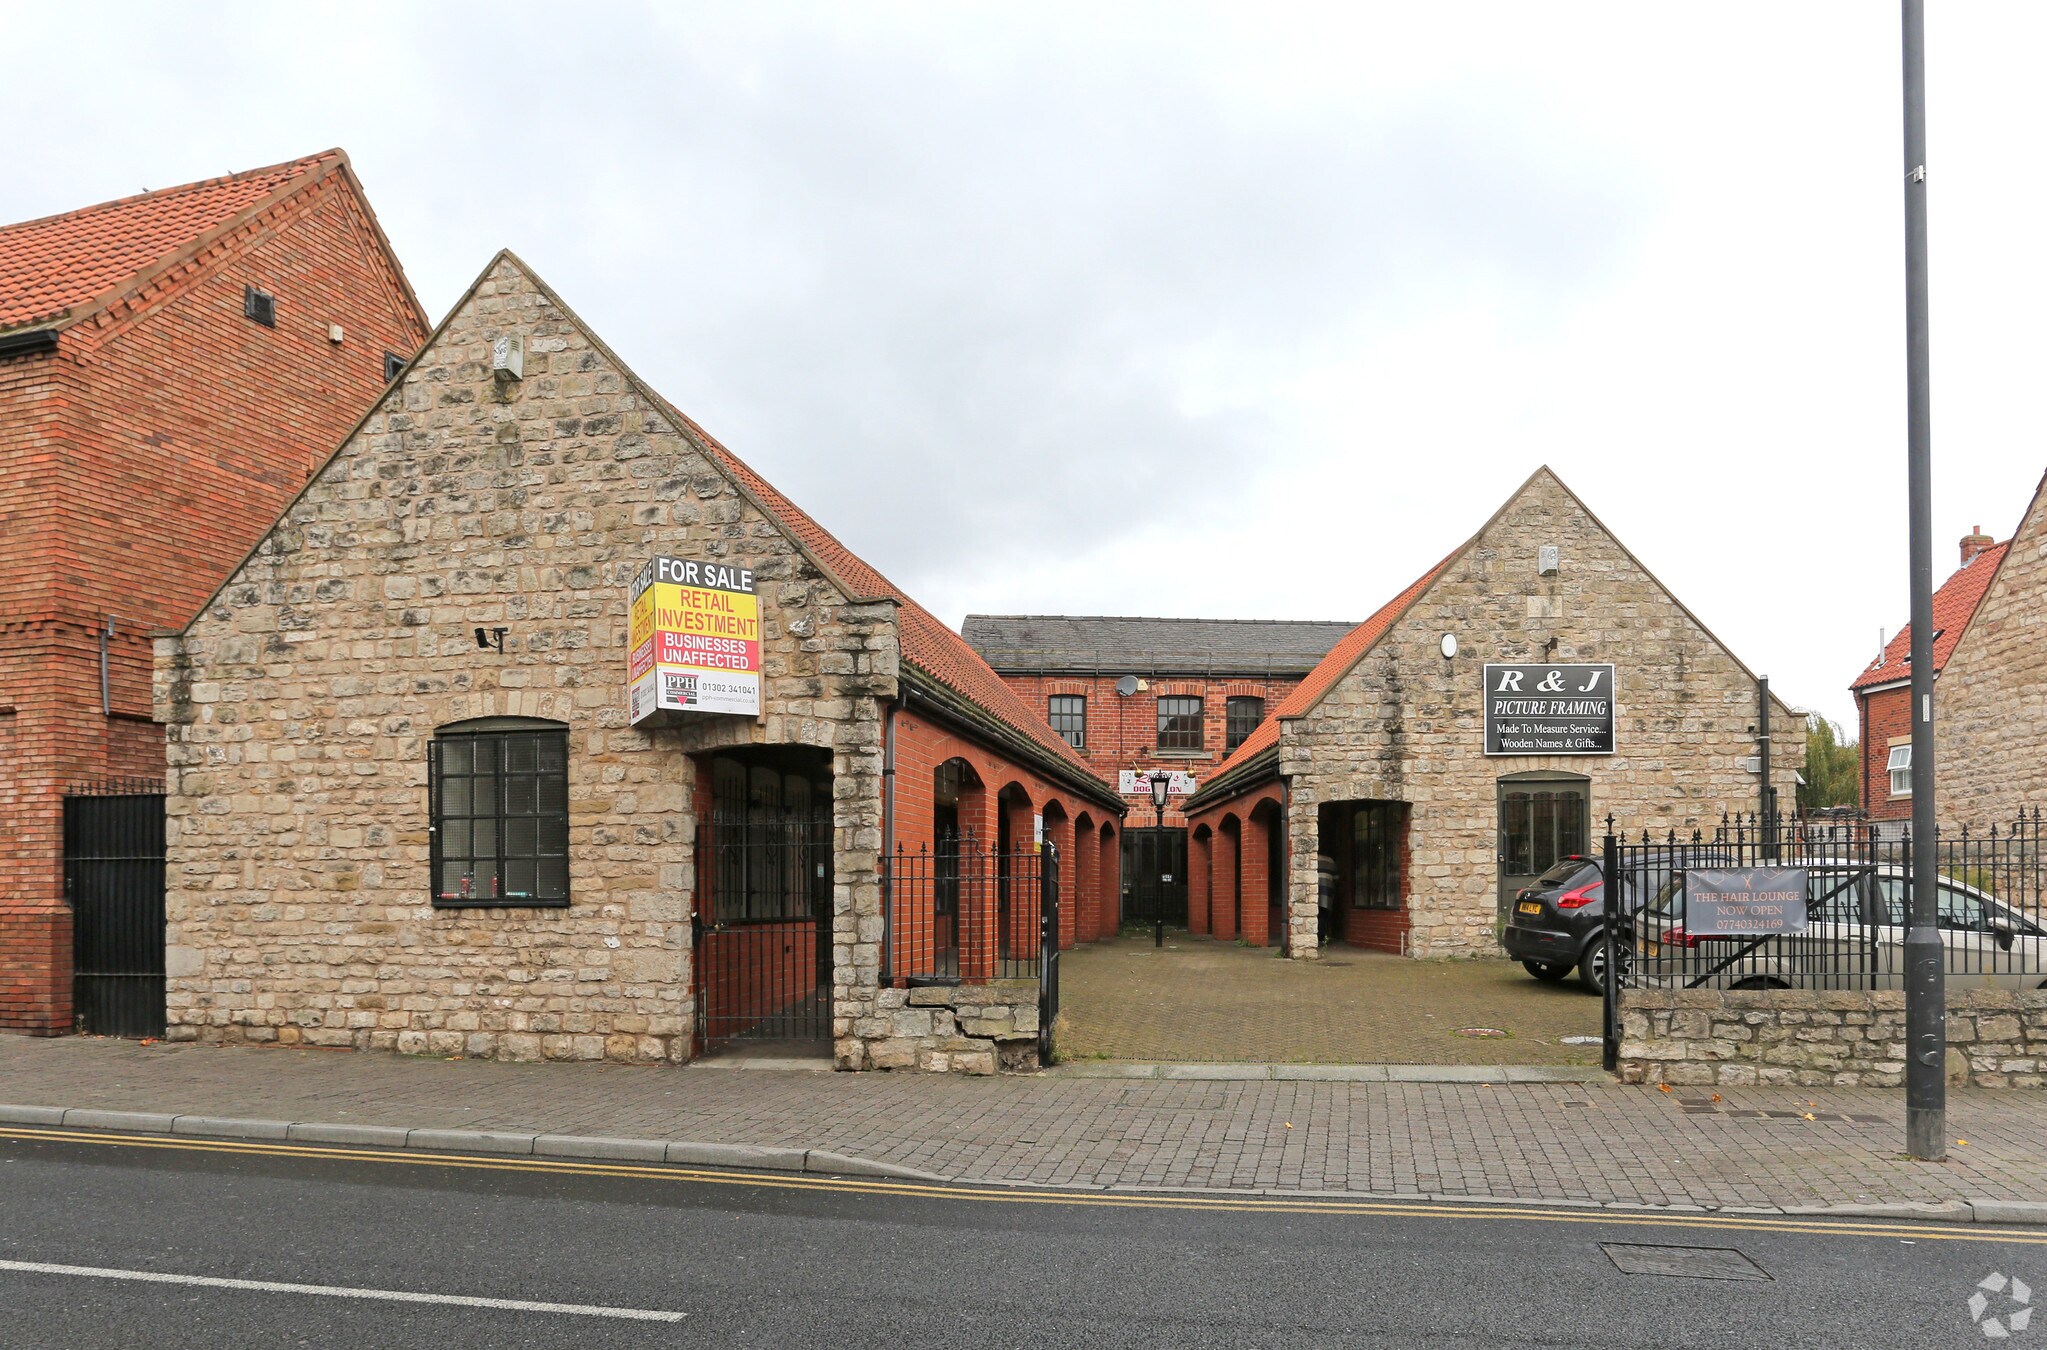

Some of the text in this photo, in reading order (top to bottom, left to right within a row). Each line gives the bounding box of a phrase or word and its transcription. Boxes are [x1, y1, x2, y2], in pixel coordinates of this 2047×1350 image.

[659, 558, 753, 592] FOR SALE
[680, 589, 734, 613] RETAIL
[657, 608, 756, 636] INVESTMENT
[665, 633, 747, 654] BUSINESSES
[663, 648, 749, 669] UNAFFECTED
[667, 675, 696, 690] PPH
[1494, 670, 1605, 692] R & J
[666, 689, 697, 697] COMMERCIAL
[702, 683, 756, 695] 01302 341041
[701, 695, 755, 704] pph-commercial.co.uk
[1494, 701, 1607, 715] PICTURE FRAMING
[1497, 724, 1607, 734] Made To Measure Service...
[1501, 738, 1602, 748] Wooden Names & Gifts...
[1694, 891, 1800, 902] THE HAIR LOUNGE
[1716, 905, 1783, 916] NOW OPEN
[1716, 920, 1783, 930] 07740324169
